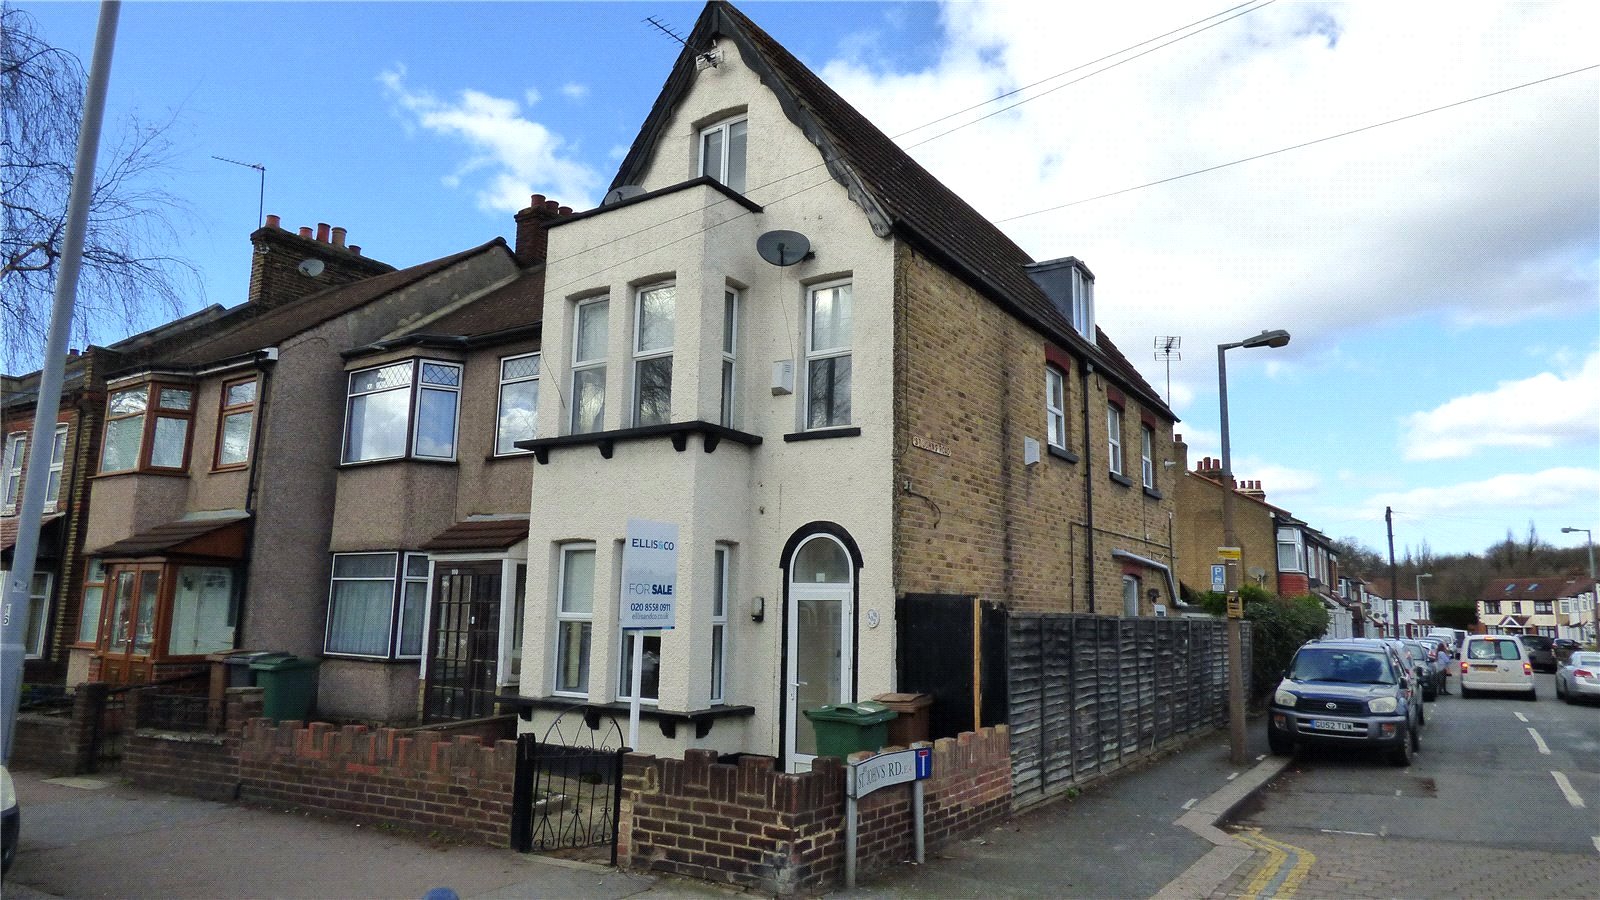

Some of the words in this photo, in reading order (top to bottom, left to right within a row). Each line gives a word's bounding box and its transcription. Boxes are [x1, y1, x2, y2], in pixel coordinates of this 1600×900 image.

[1214, 567, 1222, 576] P
[629, 583, 650, 595] FOR
[651, 584, 673, 595] SALE
[630, 603, 644, 611] 020
[644, 603, 659, 611] 8558
[659, 603, 671, 611] 0911
